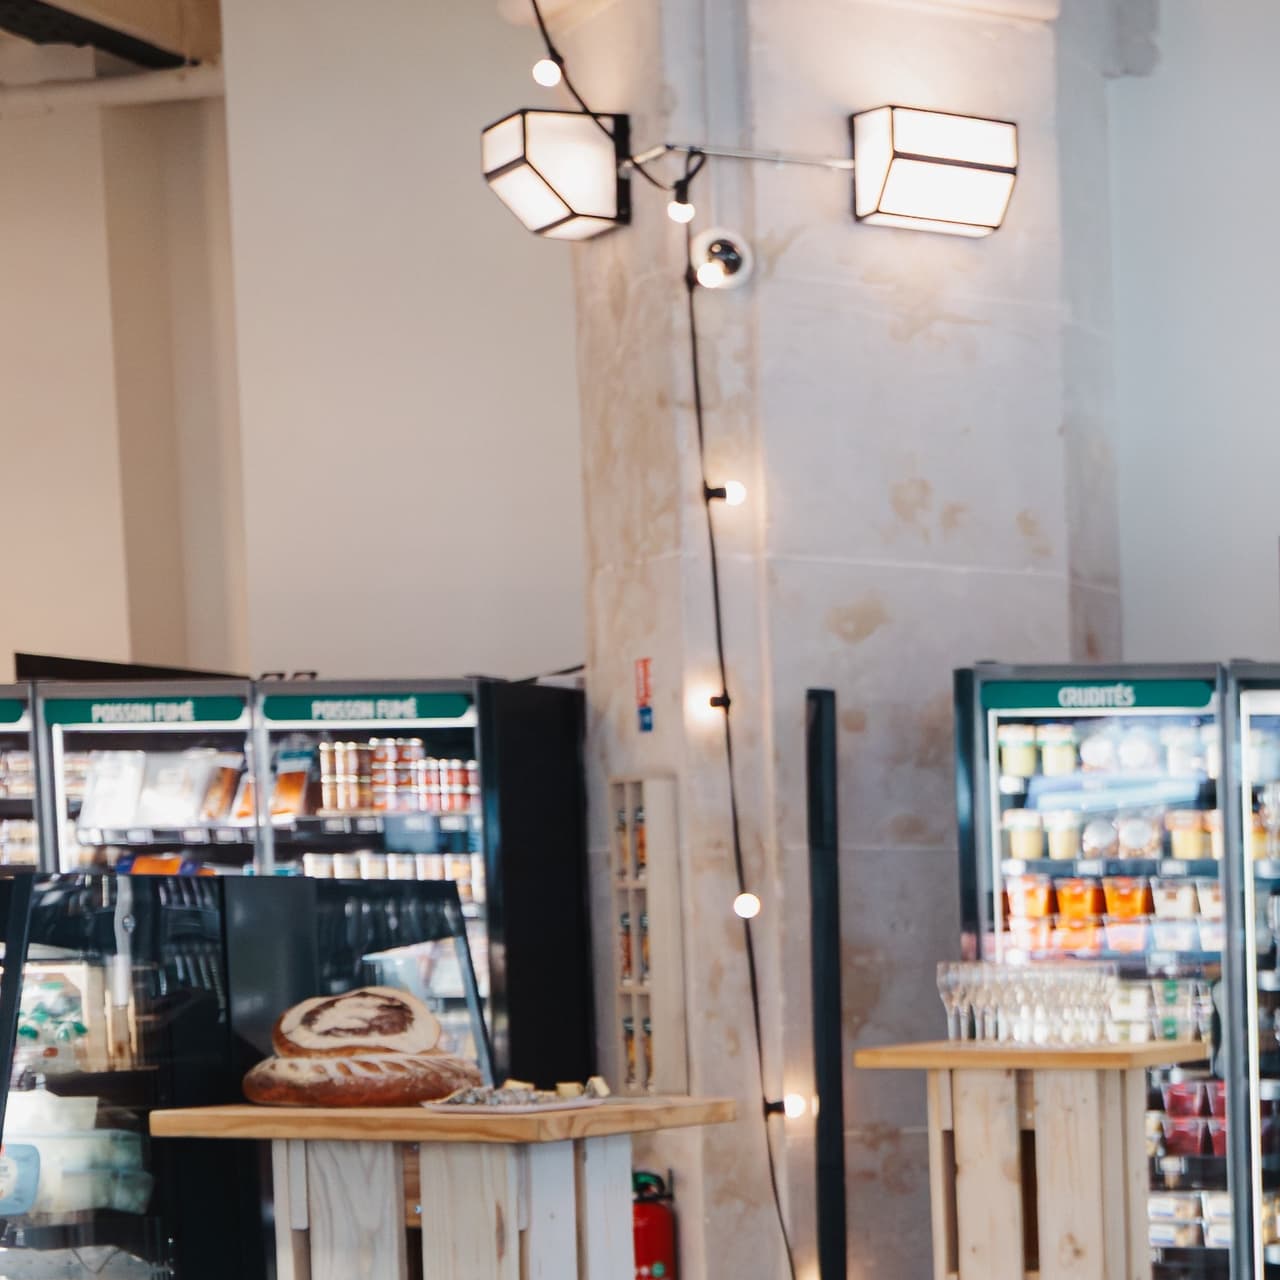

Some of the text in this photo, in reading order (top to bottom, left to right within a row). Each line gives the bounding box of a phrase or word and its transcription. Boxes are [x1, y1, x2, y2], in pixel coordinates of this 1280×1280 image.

[1058, 682, 1136, 707] CRUDITÉS
[91, 699, 195, 723] POISSON FUMÉ
[311, 696, 417, 720] POISSON FUMÉ
